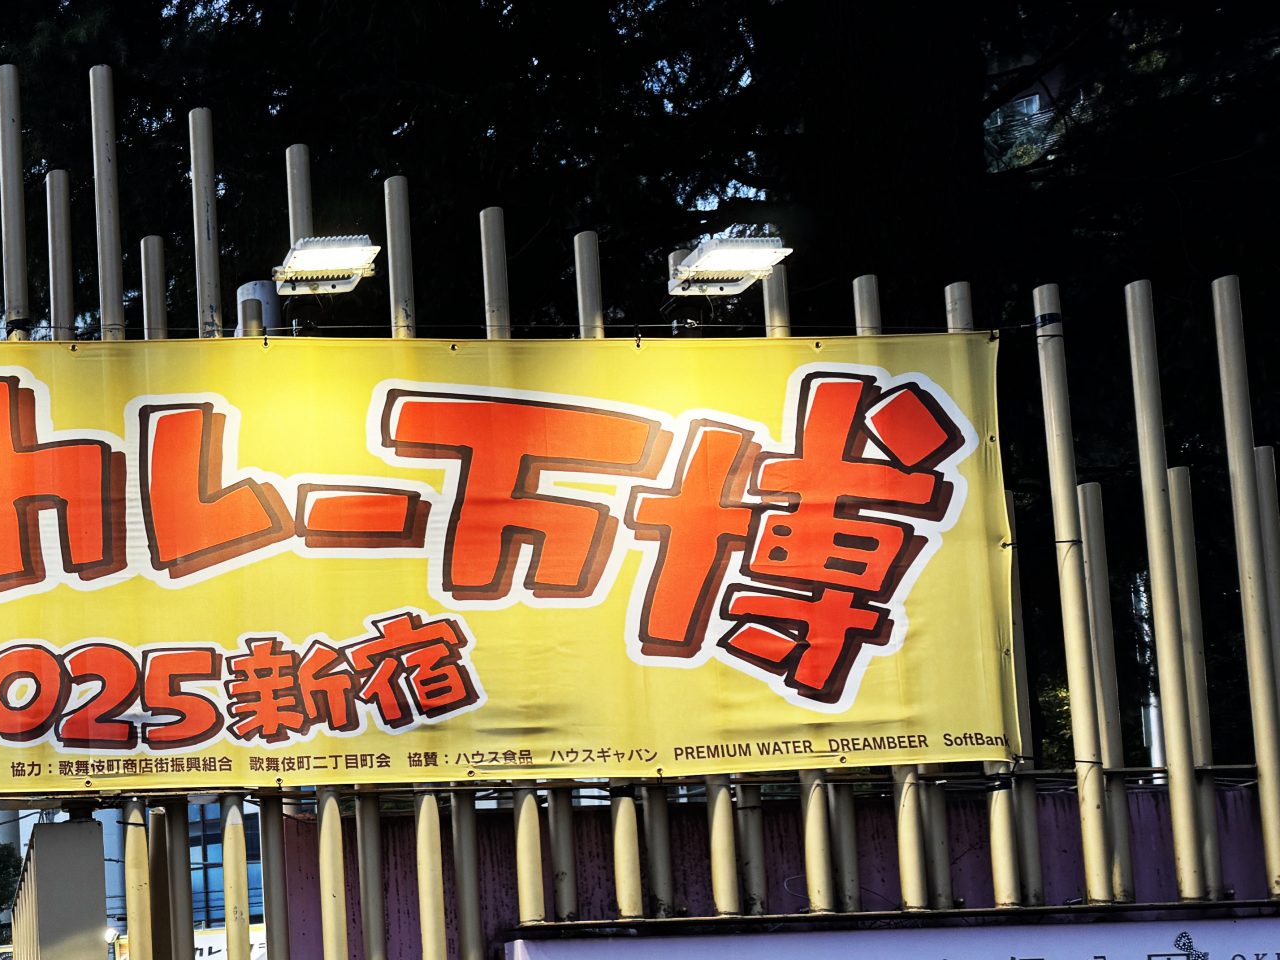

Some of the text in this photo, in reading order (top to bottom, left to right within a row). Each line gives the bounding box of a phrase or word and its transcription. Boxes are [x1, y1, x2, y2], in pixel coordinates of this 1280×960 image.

[11, 756, 233, 778] 協力：歌舞伎町商店街振興組合
[249, 753, 391, 773] 歌舞伎町二丁目町会
[550, 747, 658, 764] ハウスギャバン
[674, 741, 752, 760] PREMIUM
[756, 739, 814, 756] WATER
[828, 734, 929, 754] DREAMBEER
[943, 732, 1010, 748] SoftBank
